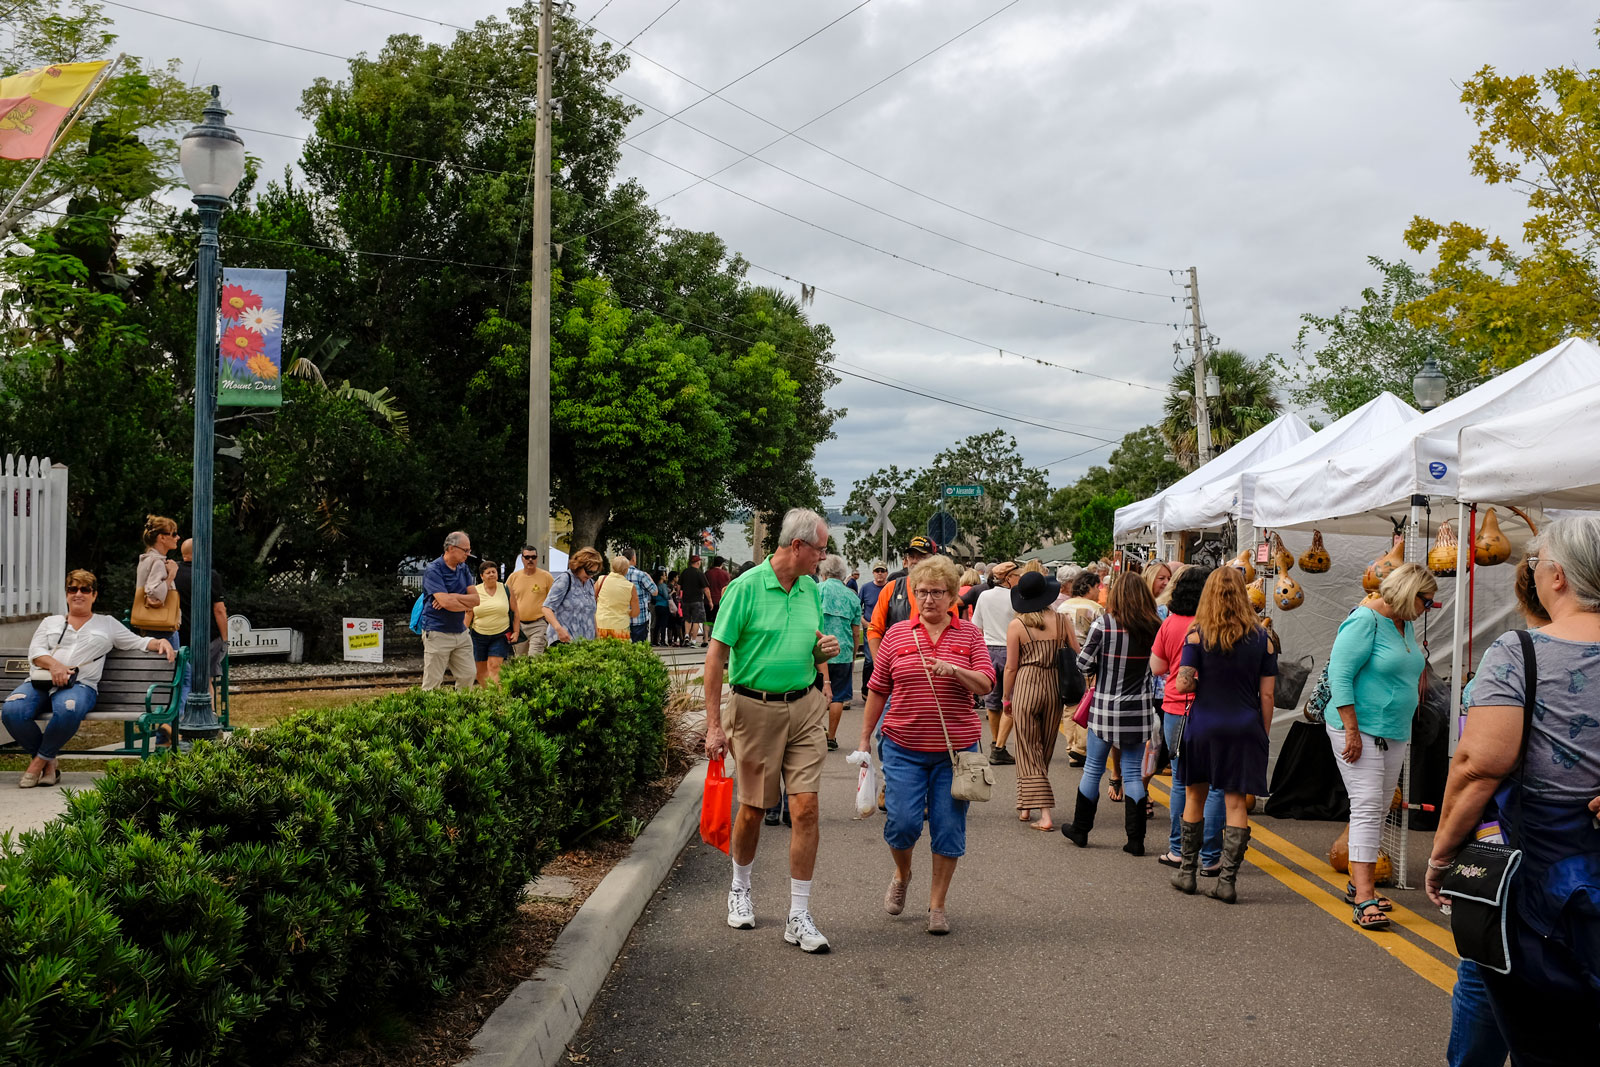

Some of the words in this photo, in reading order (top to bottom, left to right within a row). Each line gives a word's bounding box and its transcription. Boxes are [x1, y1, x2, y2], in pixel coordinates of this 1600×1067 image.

[222, 380, 252, 390] Mount
[255, 381, 277, 390] Dora
[956, 487, 975, 495] Alexander
[256, 634, 278, 646] Inn
